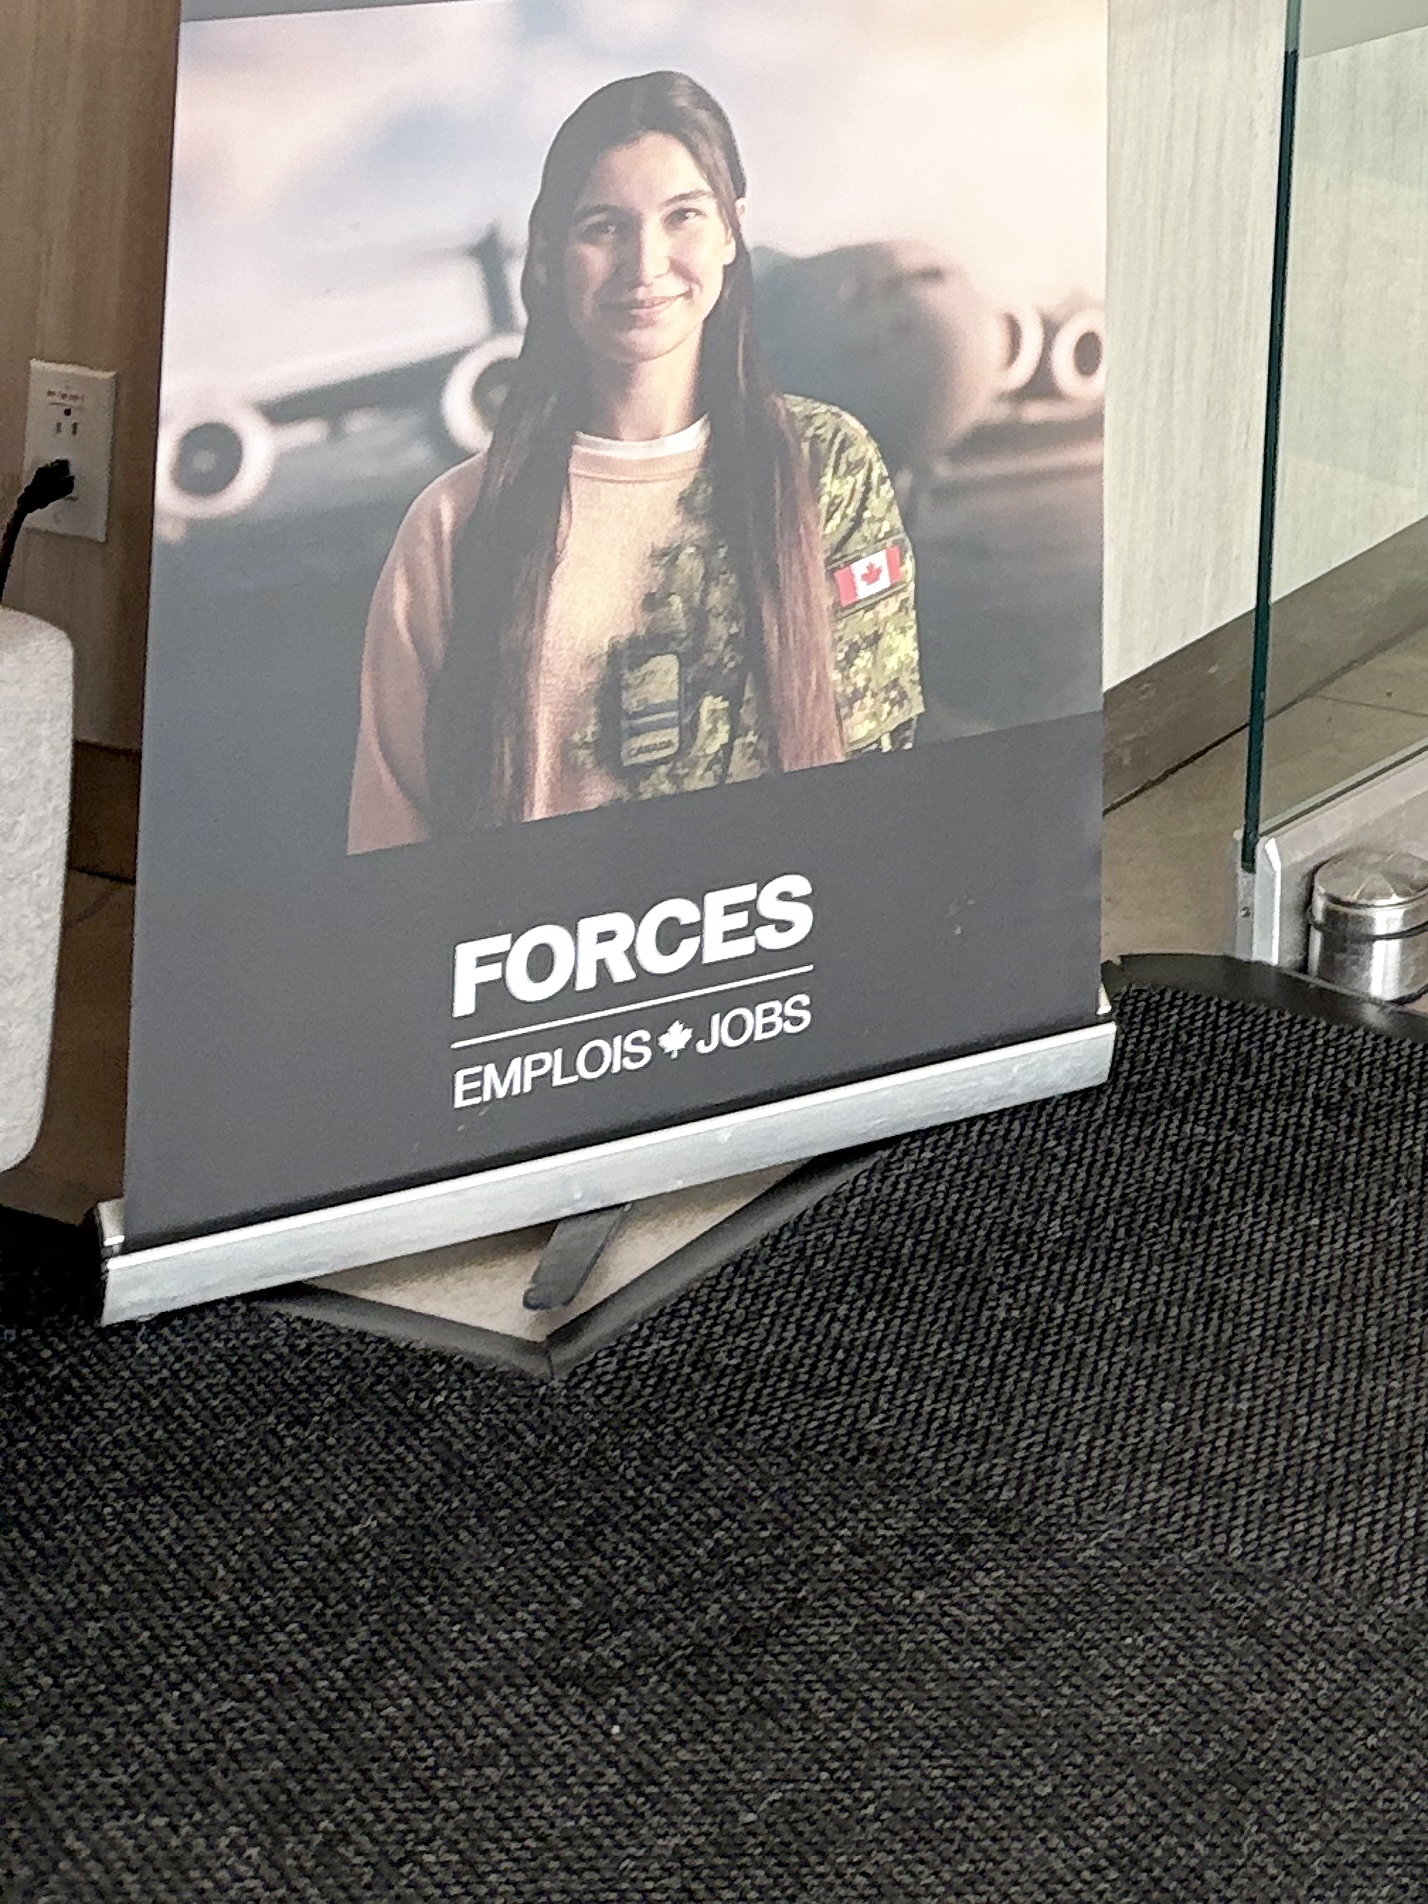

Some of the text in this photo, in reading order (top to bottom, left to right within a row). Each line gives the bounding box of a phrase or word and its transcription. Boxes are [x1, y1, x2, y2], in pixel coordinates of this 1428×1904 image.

[452, 874, 815, 1018] FORCES
[453, 993, 812, 1109] EMPLOIS JOBS
